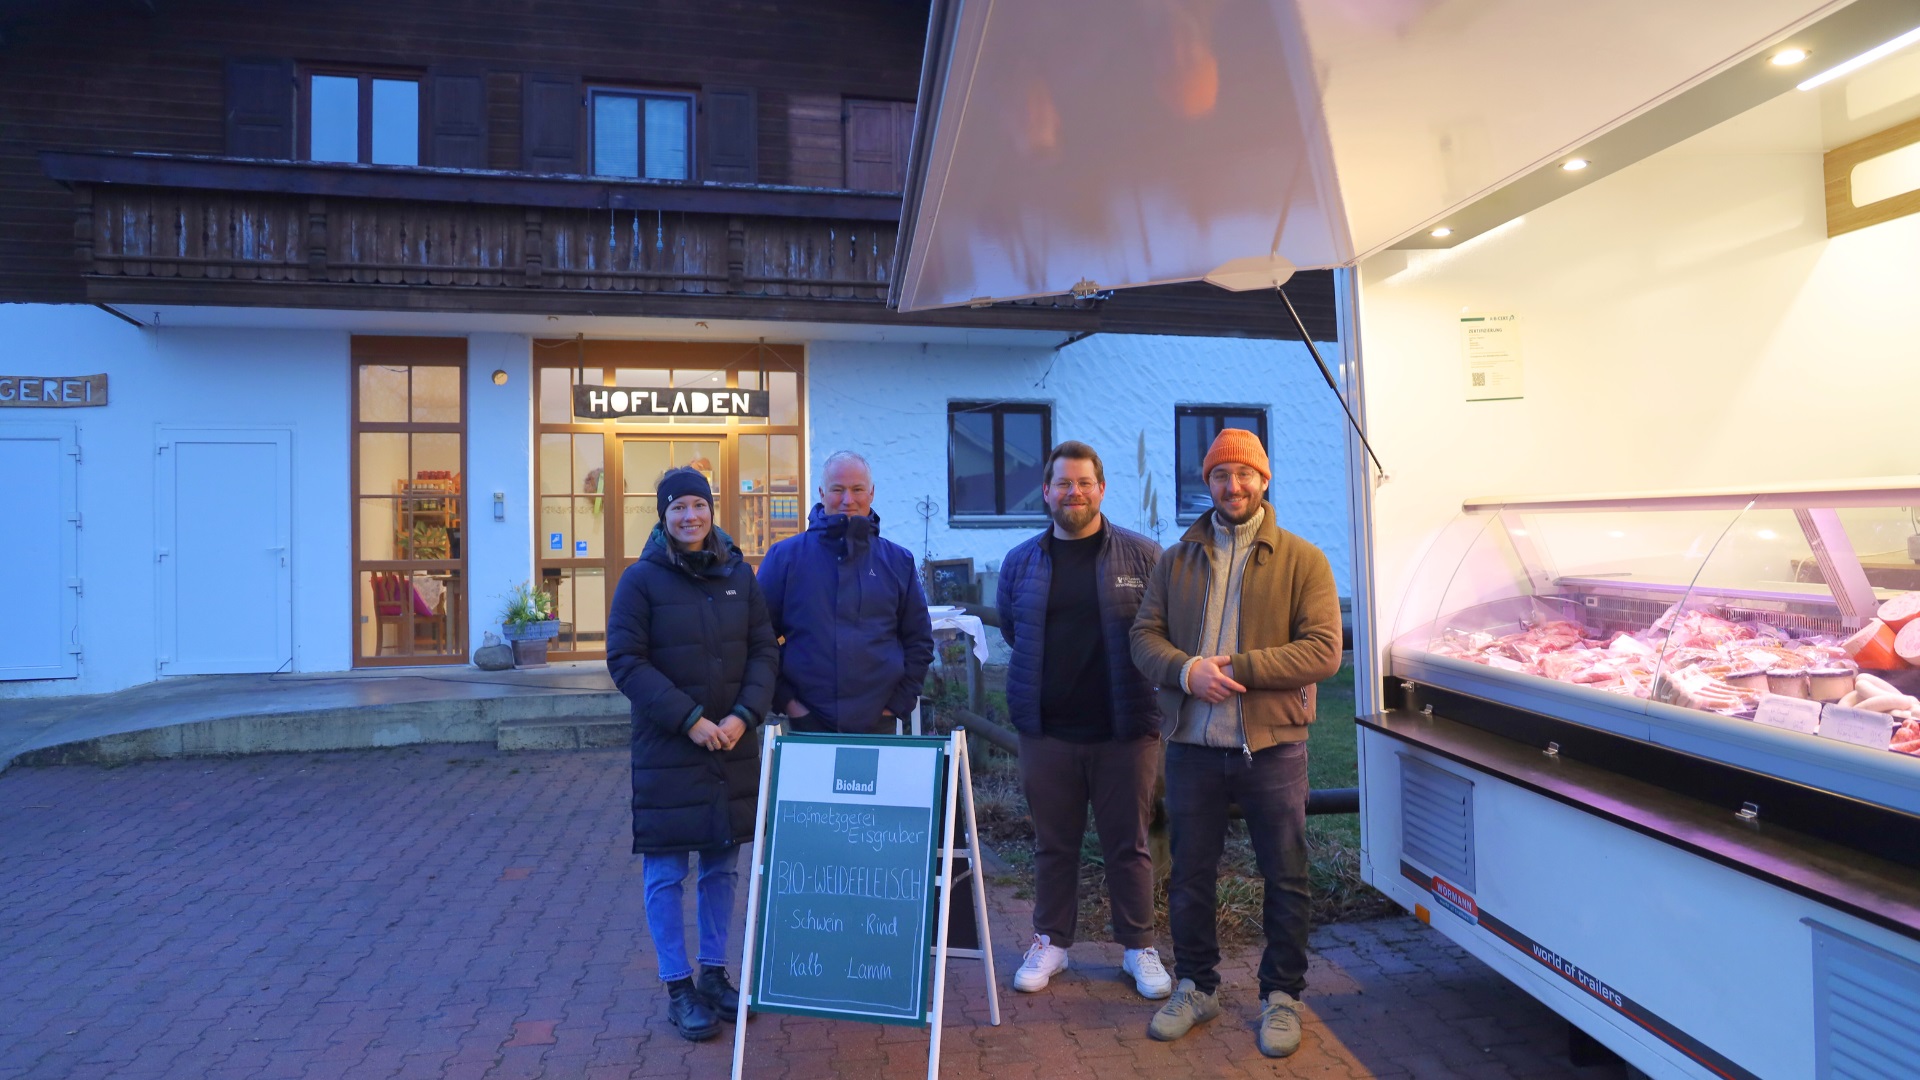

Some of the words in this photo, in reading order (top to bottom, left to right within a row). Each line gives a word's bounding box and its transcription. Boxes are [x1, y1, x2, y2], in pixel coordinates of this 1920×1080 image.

[0, 379, 91, 402] GEREI
[589, 390, 750, 414] HOFLADEN
[835, 778, 874, 793] Bioland
[783, 803, 876, 833] Hofmetzgerei
[847, 821, 924, 852] Eisgruber
[777, 860, 921, 900] BIO-WEIDEFLEISCH
[1436, 881, 1472, 912] WÖRMANN
[790, 908, 844, 933] Schwein
[866, 912, 899, 937] Rind
[789, 951, 823, 977] Kalb
[846, 956, 893, 980] Lamm
[1532, 943, 1562, 970] world
[1564, 963, 1576, 978] of
[1578, 970, 1623, 1007] trailers
